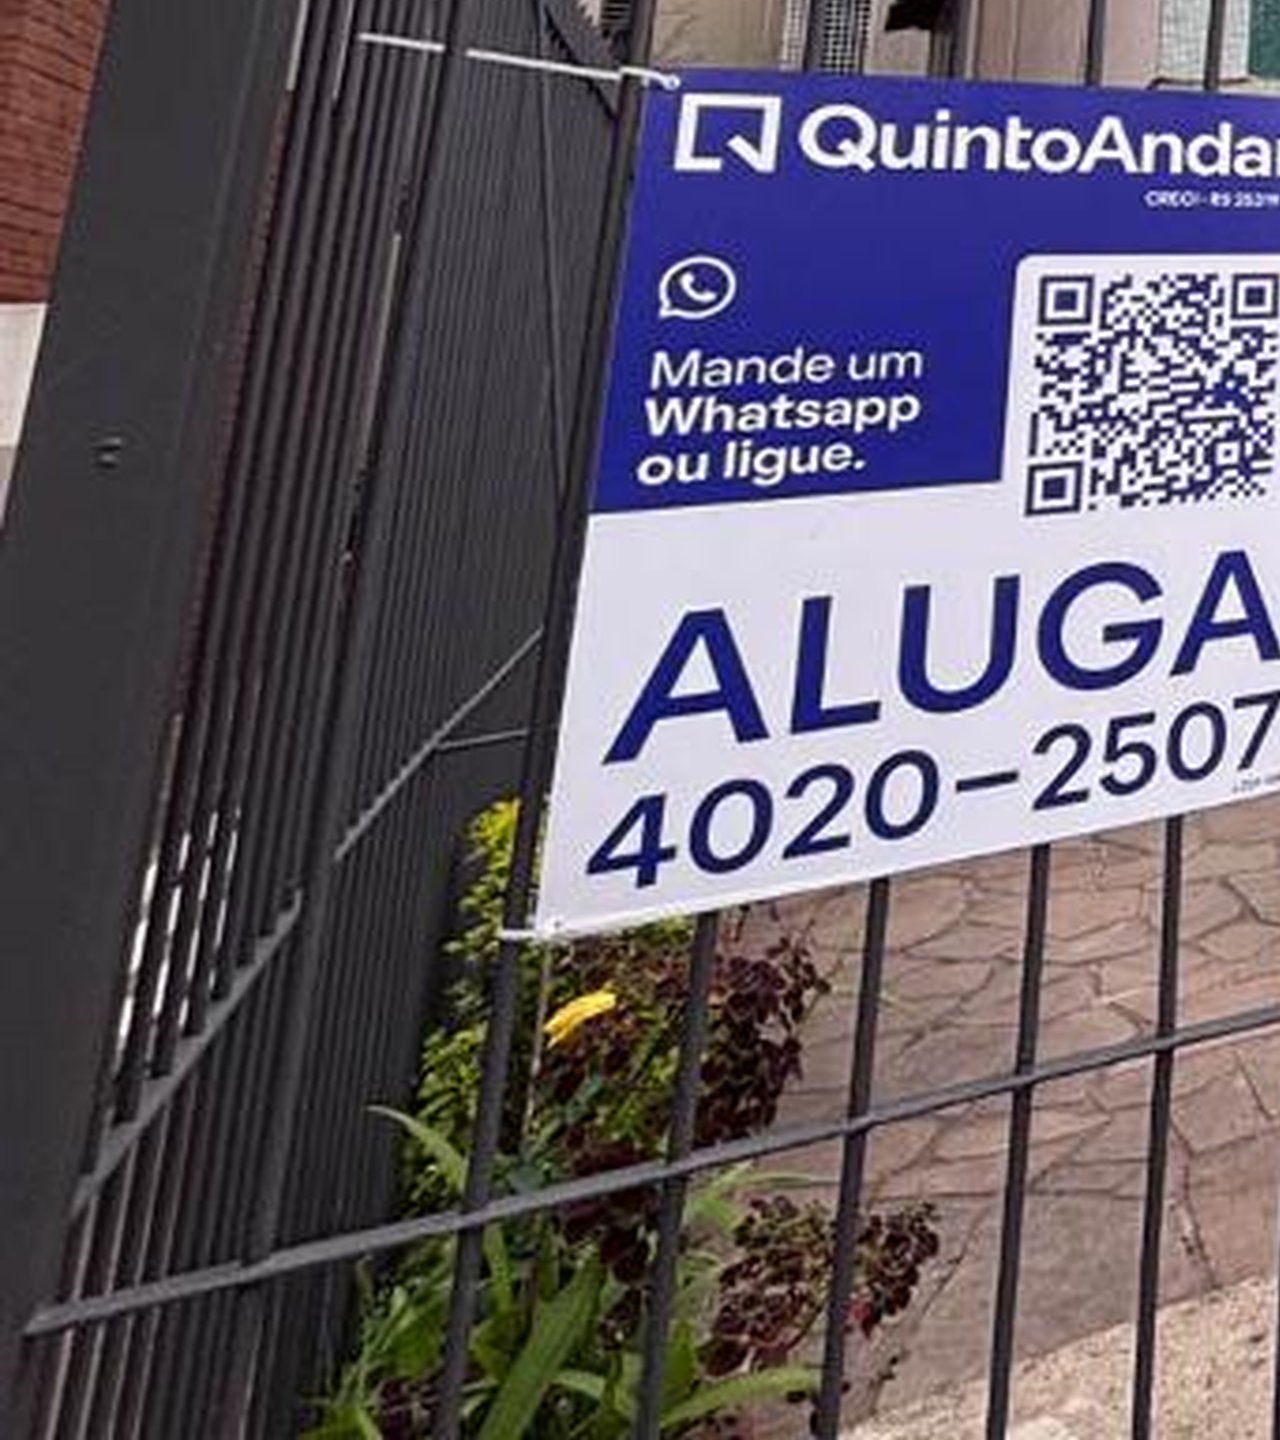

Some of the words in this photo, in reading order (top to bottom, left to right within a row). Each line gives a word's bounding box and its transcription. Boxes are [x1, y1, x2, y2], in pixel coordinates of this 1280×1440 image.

[650, 346, 835, 390] Mande
[848, 351, 923, 381] um
[644, 394, 921, 437] Whatsapp
[637, 452, 709, 485] ou
[723, 439, 866, 487] ligue.
